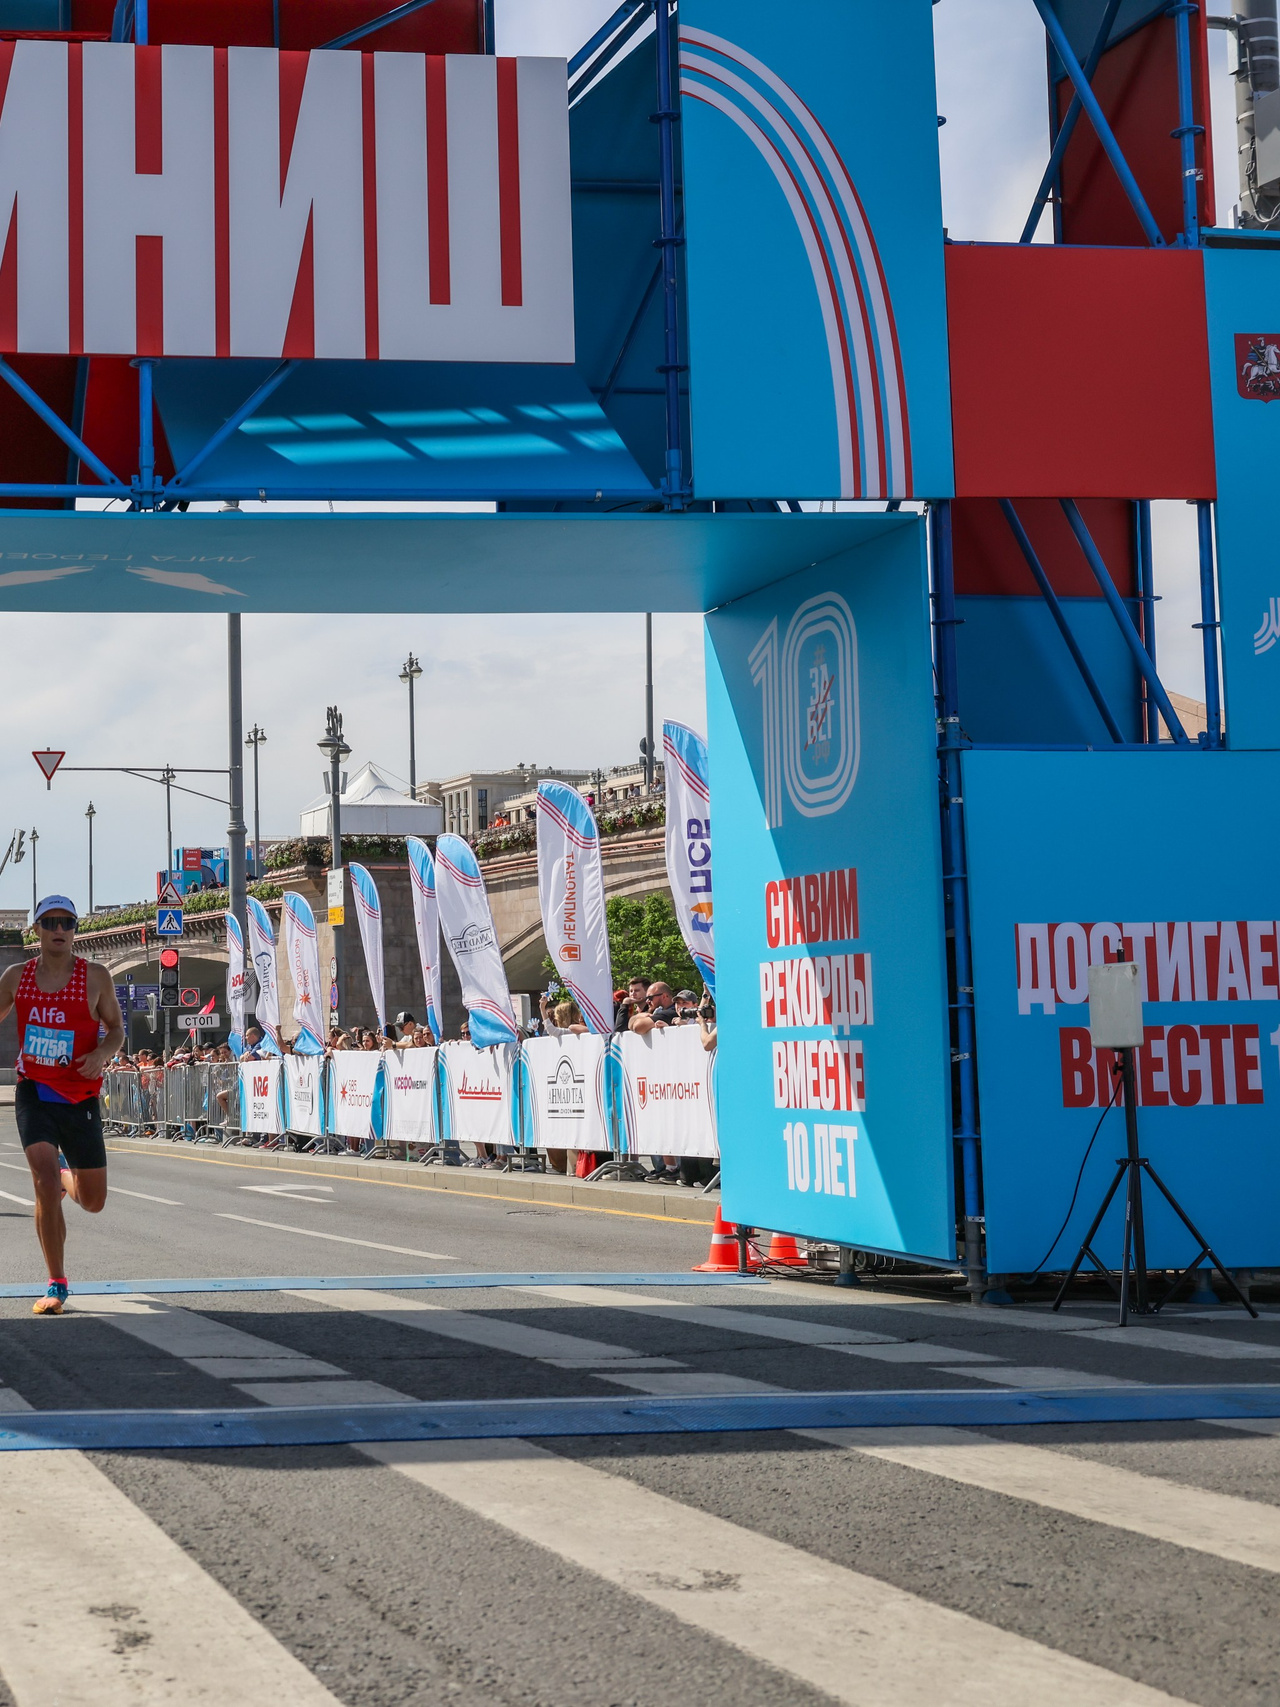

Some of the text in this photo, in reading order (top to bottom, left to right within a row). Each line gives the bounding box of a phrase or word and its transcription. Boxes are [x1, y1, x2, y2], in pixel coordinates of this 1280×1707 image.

[151, 554, 256, 563] ЛИГА
[748, 591, 860, 830] 10
[765, 867, 860, 949] СТАВИМ
[1017, 921, 1280, 1015] ДОСТИГАЕ
[759, 953, 874, 1036] РЕКОРДЫ
[28, 1006, 65, 1024] Alfa
[184, 1016, 213, 1026] СТОП
[28, 1035, 68, 1058] 71758
[58, 1055, 68, 1066] A
[772, 1039, 866, 1112] ВМЕСТЕ
[548, 1087, 584, 1104] AHMAD TEA
[649, 1082, 700, 1101] ЧЕМПИОНАТ
[783, 1121, 858, 1198] 10 ЛЕТ
